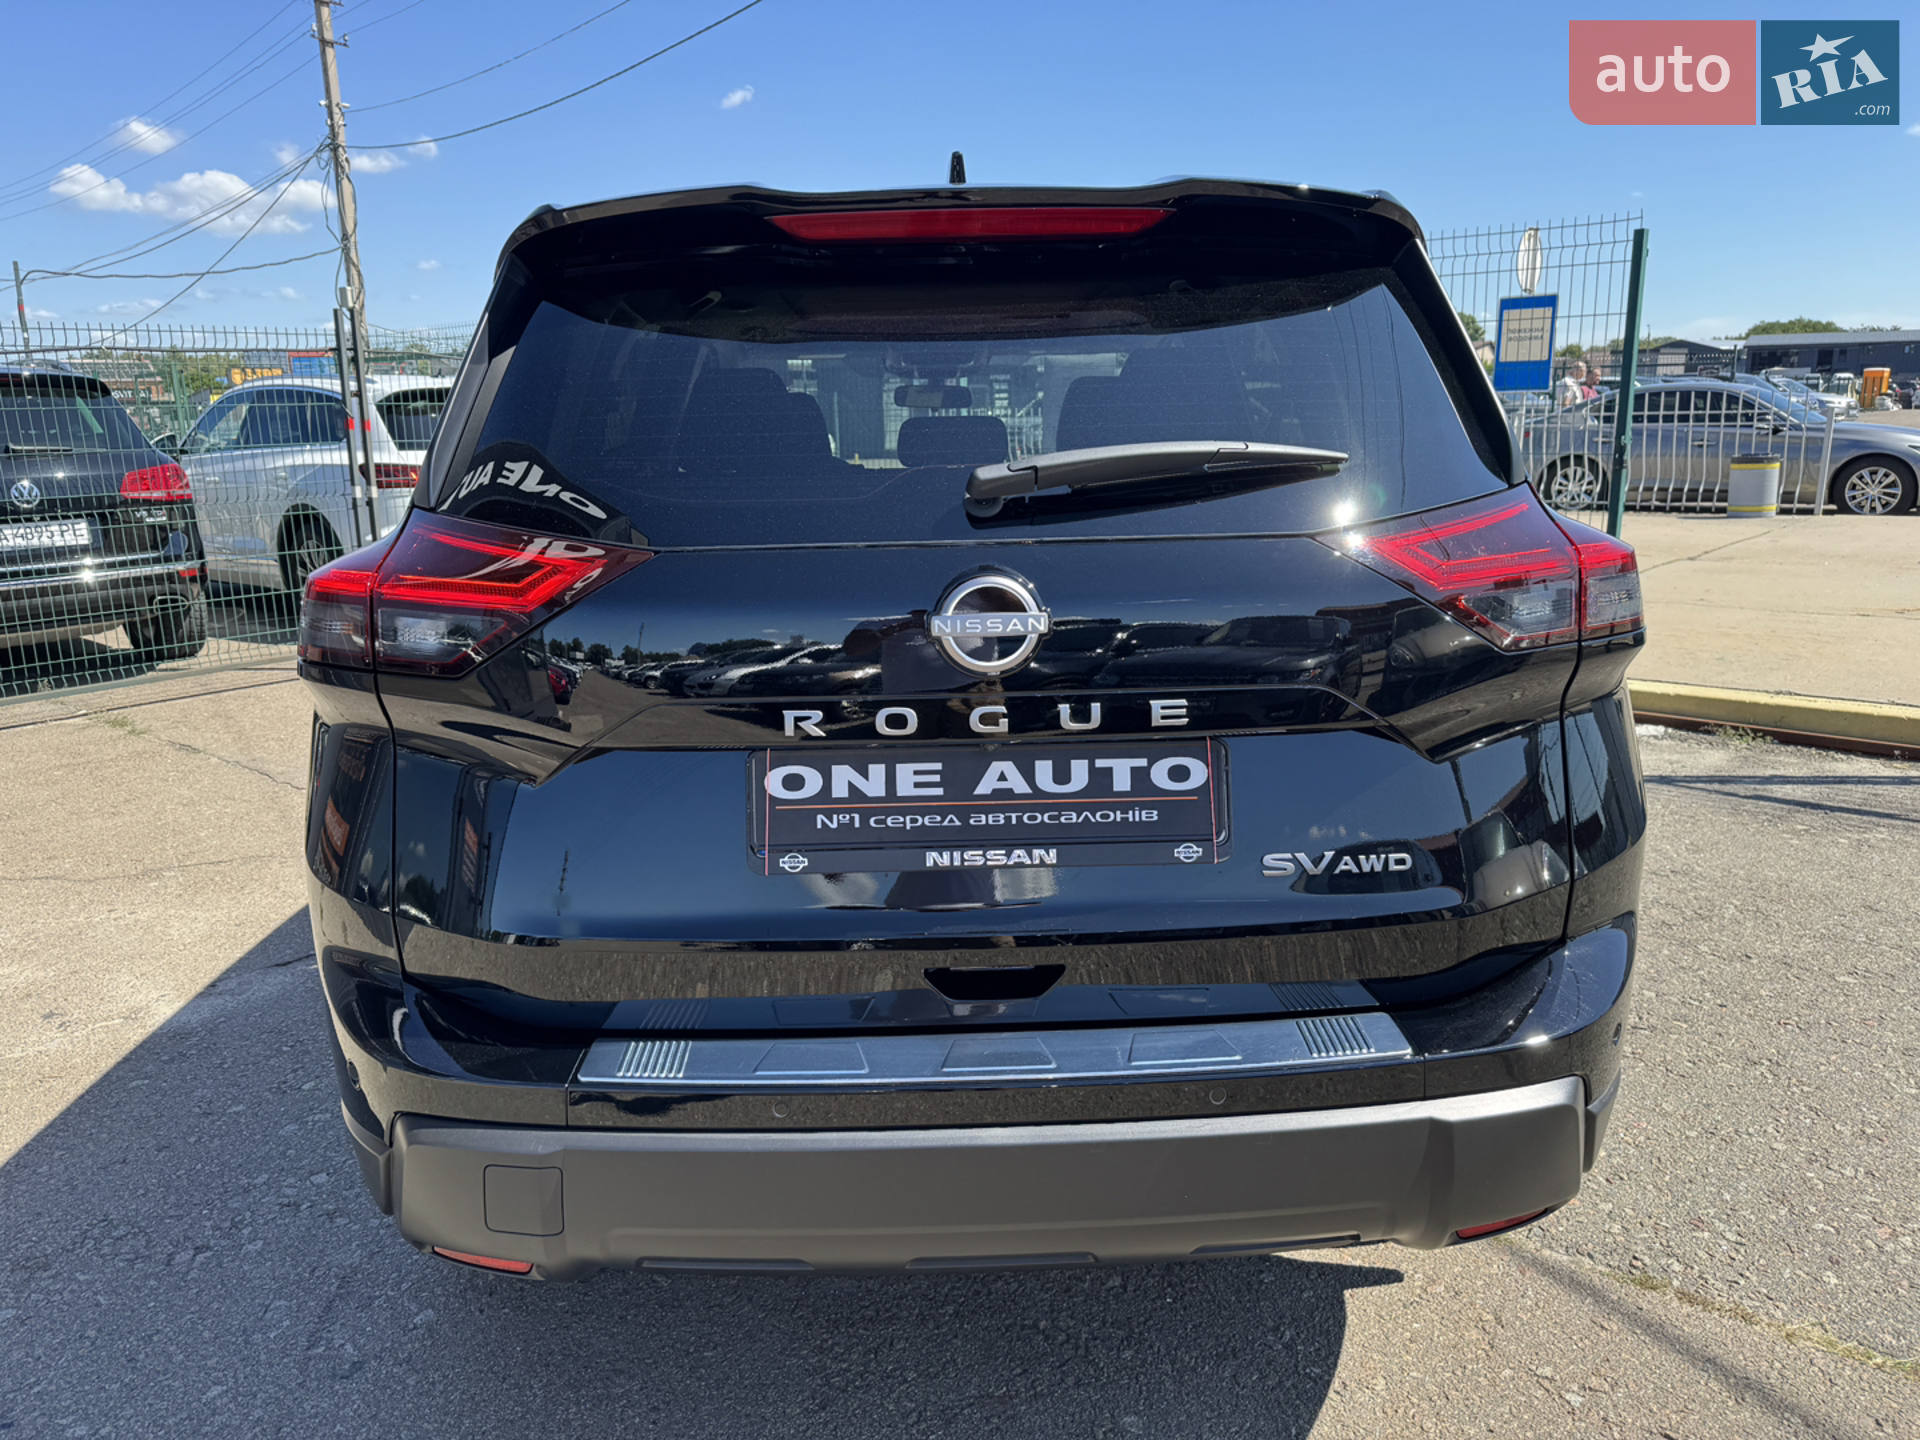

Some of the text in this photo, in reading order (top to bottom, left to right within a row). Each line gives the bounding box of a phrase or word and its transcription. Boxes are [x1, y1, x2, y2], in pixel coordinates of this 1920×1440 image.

[15, 525, 55, 541] 4895
[934, 616, 1045, 634] NISSAN
[782, 699, 1189, 737] ROGUE
[764, 756, 1208, 800] ONE AUTO
[869, 812, 962, 830] серед
[969, 807, 1159, 827] автосалонів
[781, 858, 806, 866] NISSAN
[925, 847, 1058, 867] NISSAN
[1261, 850, 1413, 878] SV AWD
